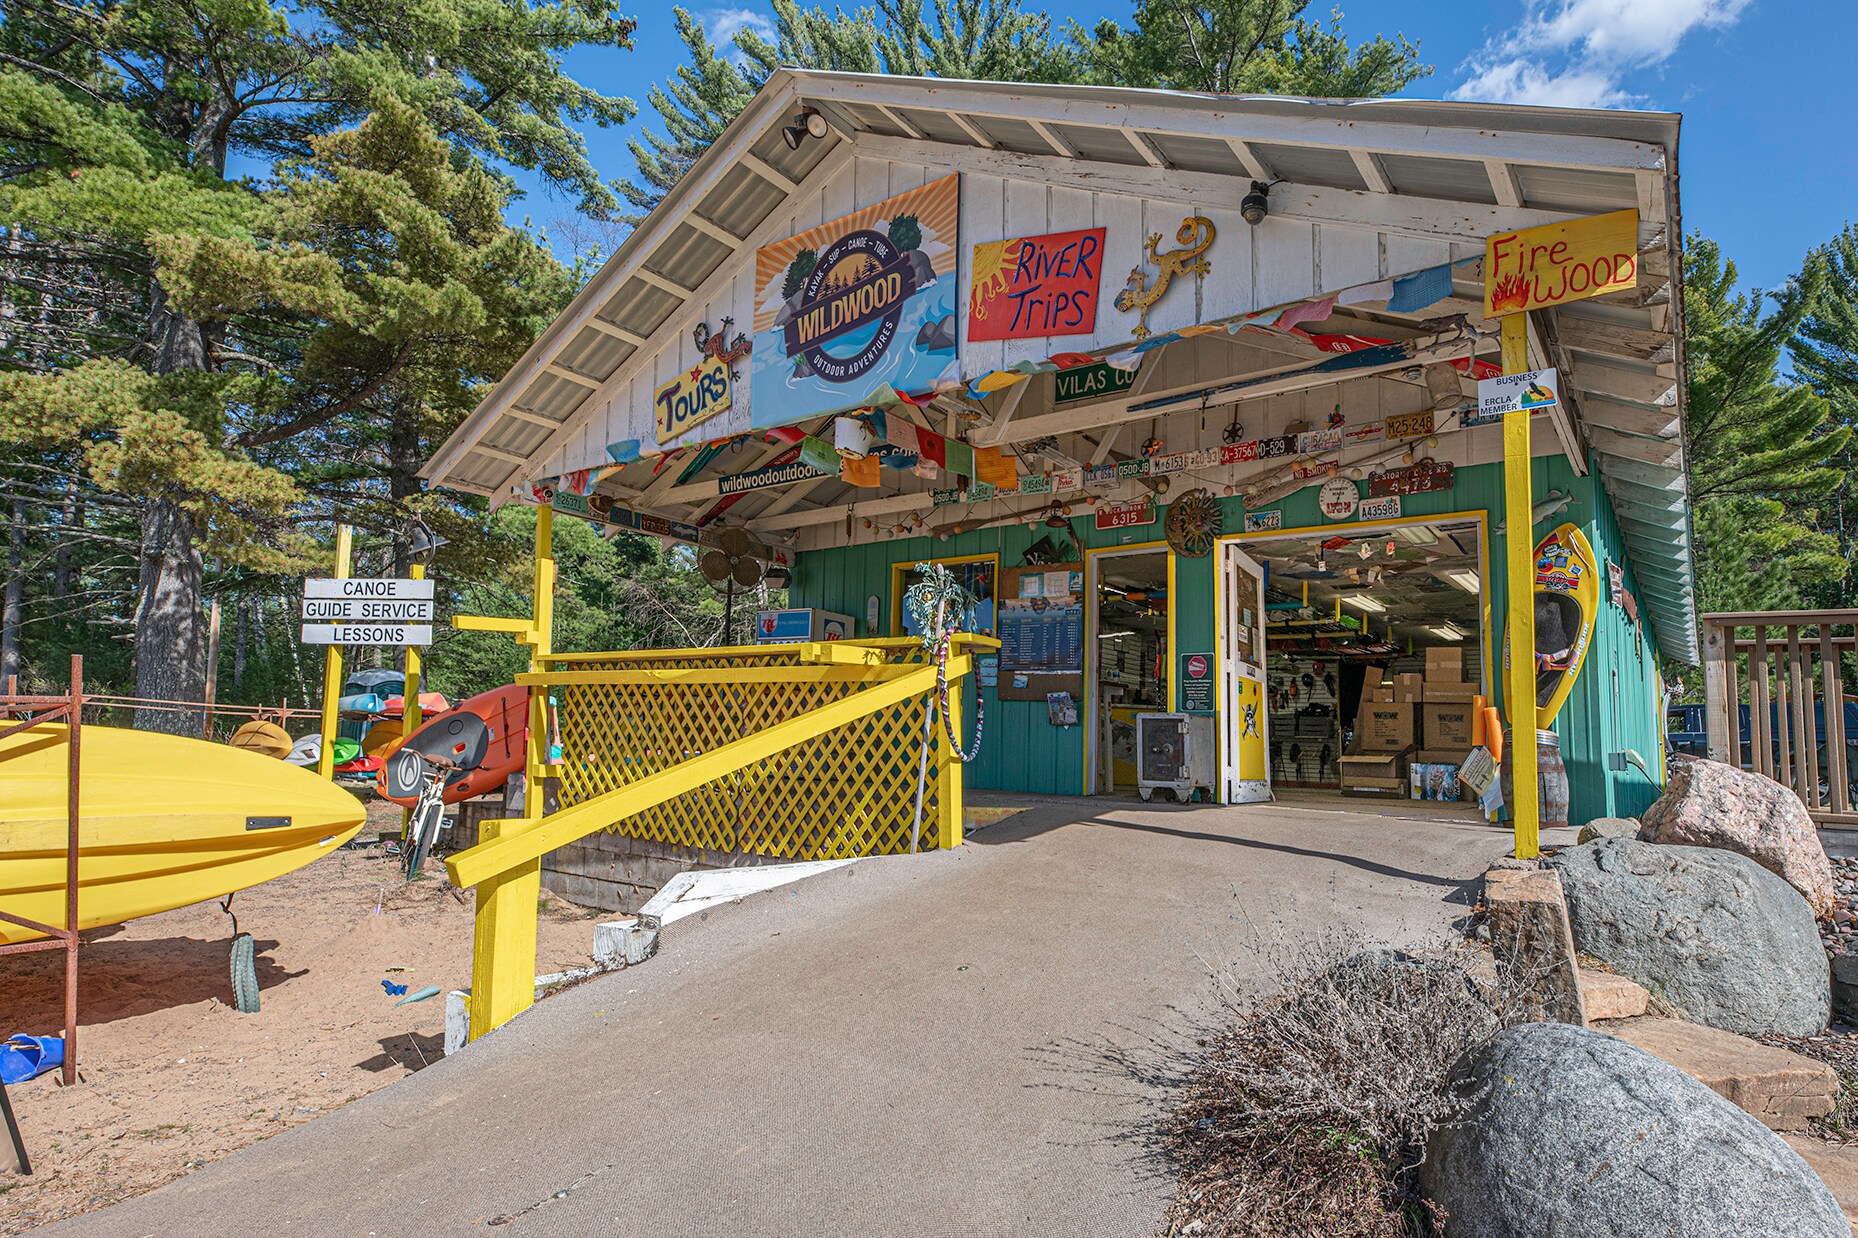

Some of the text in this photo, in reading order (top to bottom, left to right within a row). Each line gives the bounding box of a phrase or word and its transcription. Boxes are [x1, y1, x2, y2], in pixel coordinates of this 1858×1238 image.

[807, 236, 889, 298] KAYAK SUP CANOE TUBE
[797, 272, 902, 345] WILDWOOD
[813, 321, 894, 377] OUTDOOR ADVENTURES
[1057, 369, 1107, 396] VILAS
[1496, 372, 1538, 386] BUSINESS
[1480, 402, 1518, 415] MEMBER
[1484, 396, 1512, 406] ERCLA
[1294, 471, 1304, 480] NO
[1361, 503, 1399, 518] A43598G
[1112, 512, 1138, 525] 6315
[343, 581, 396, 596] CANOE
[306, 602, 427, 618] GUIDE SERVICE
[333, 627, 404, 642] LESSONS
